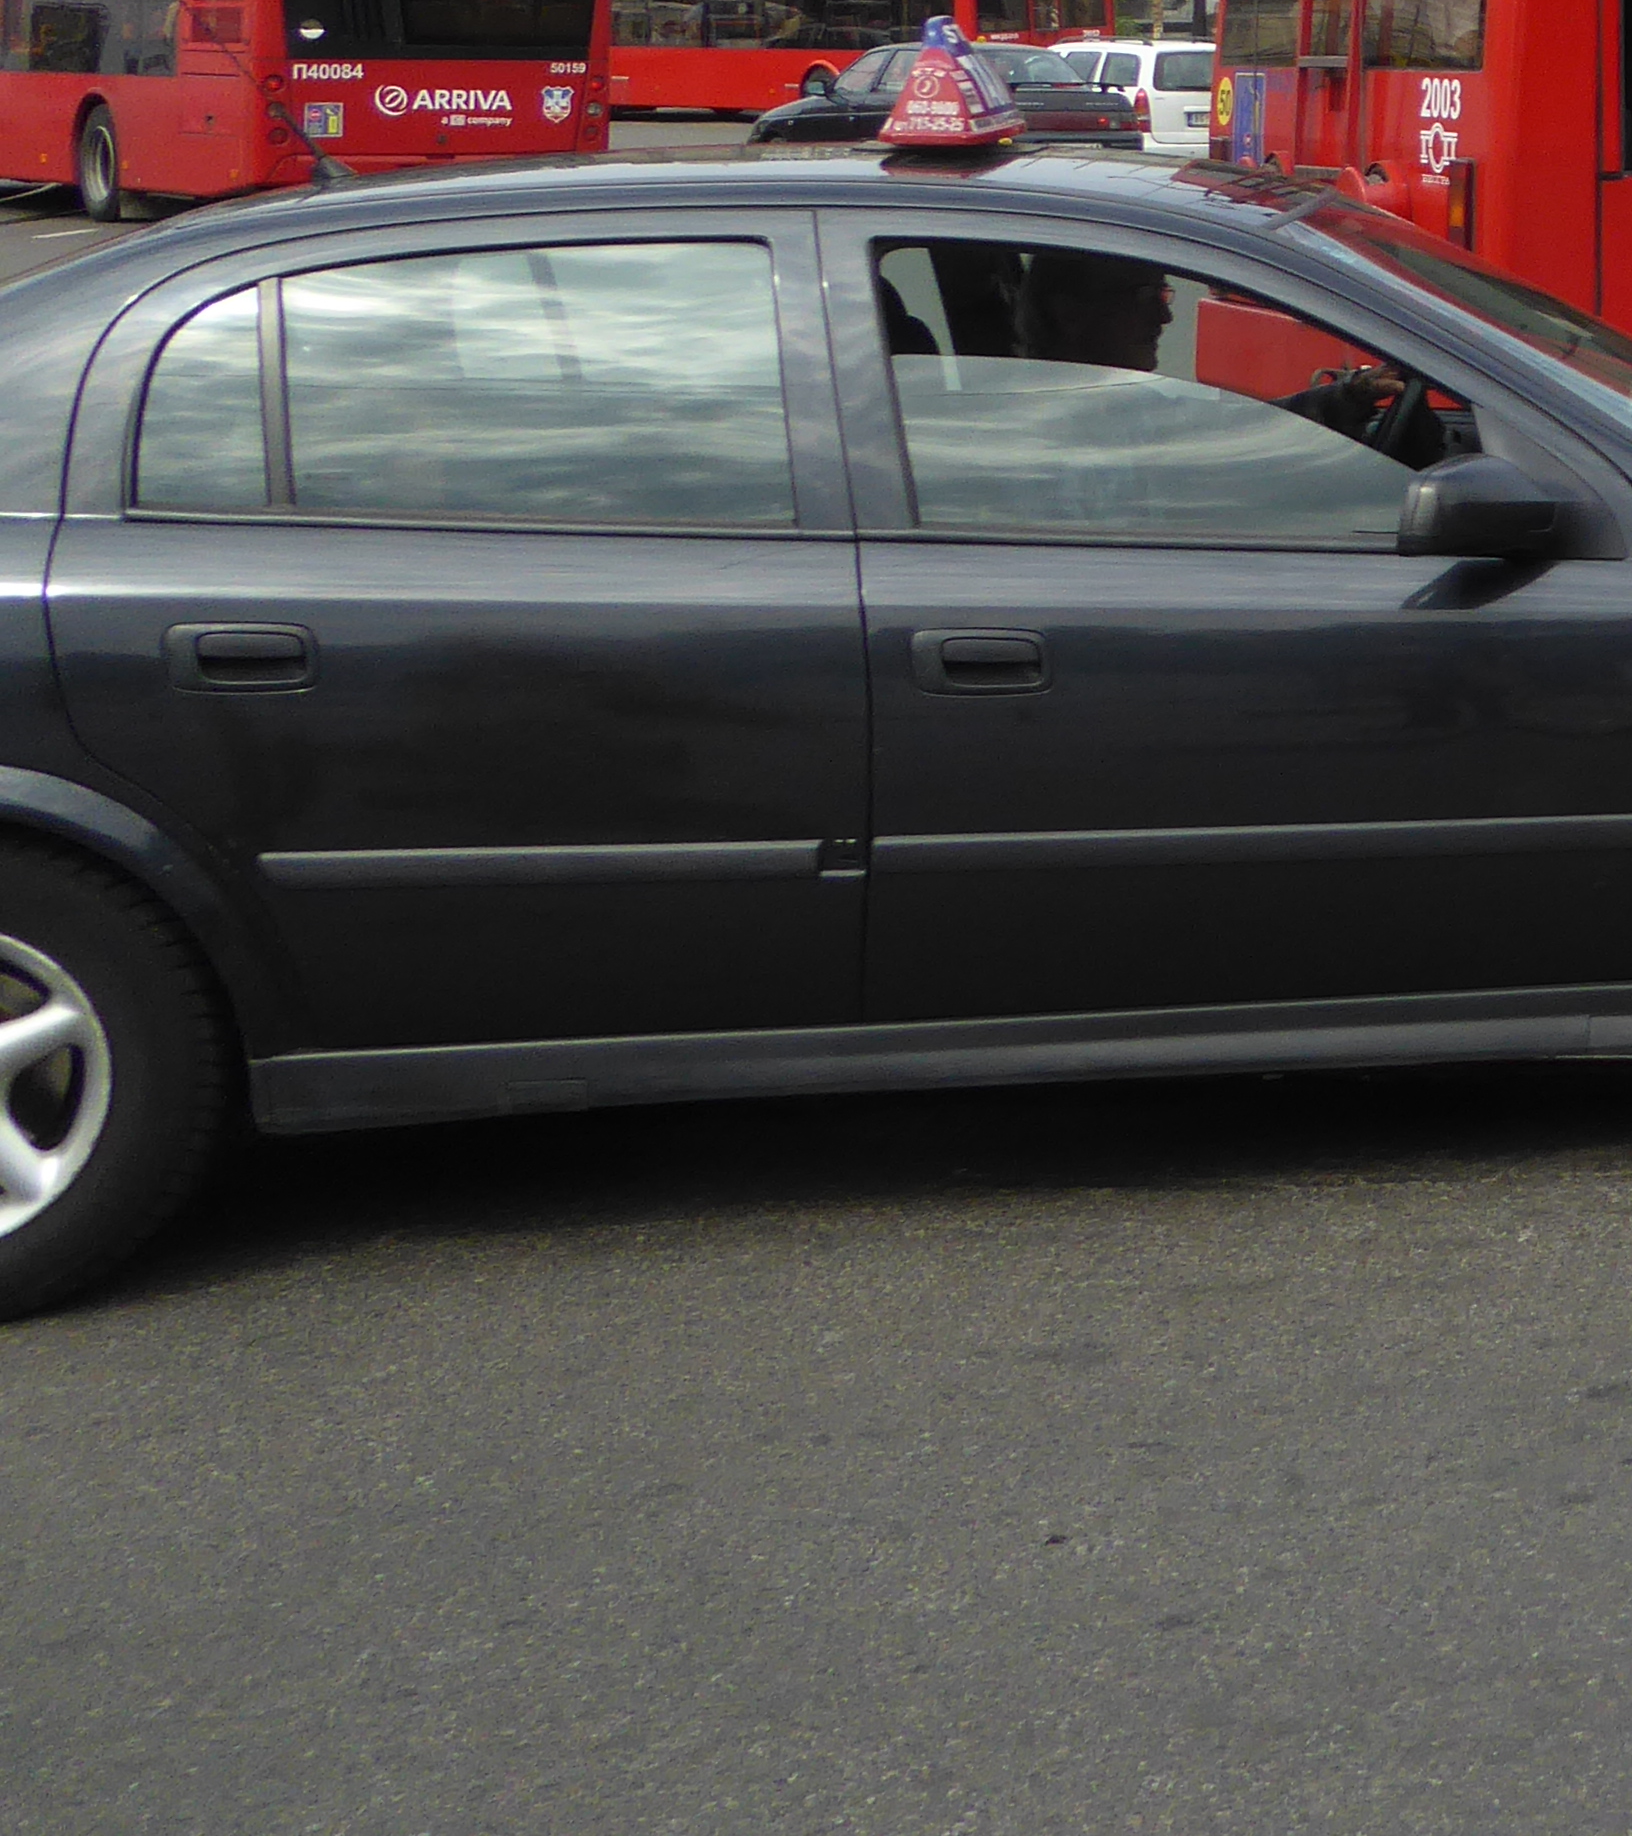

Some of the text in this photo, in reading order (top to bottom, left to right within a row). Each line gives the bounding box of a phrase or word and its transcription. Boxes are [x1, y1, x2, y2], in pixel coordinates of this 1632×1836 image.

[292, 62, 364, 80] П40084
[550, 62, 587, 74] 50159
[411, 89, 513, 111] ARRIVA
[1420, 76, 1462, 120] 2003
